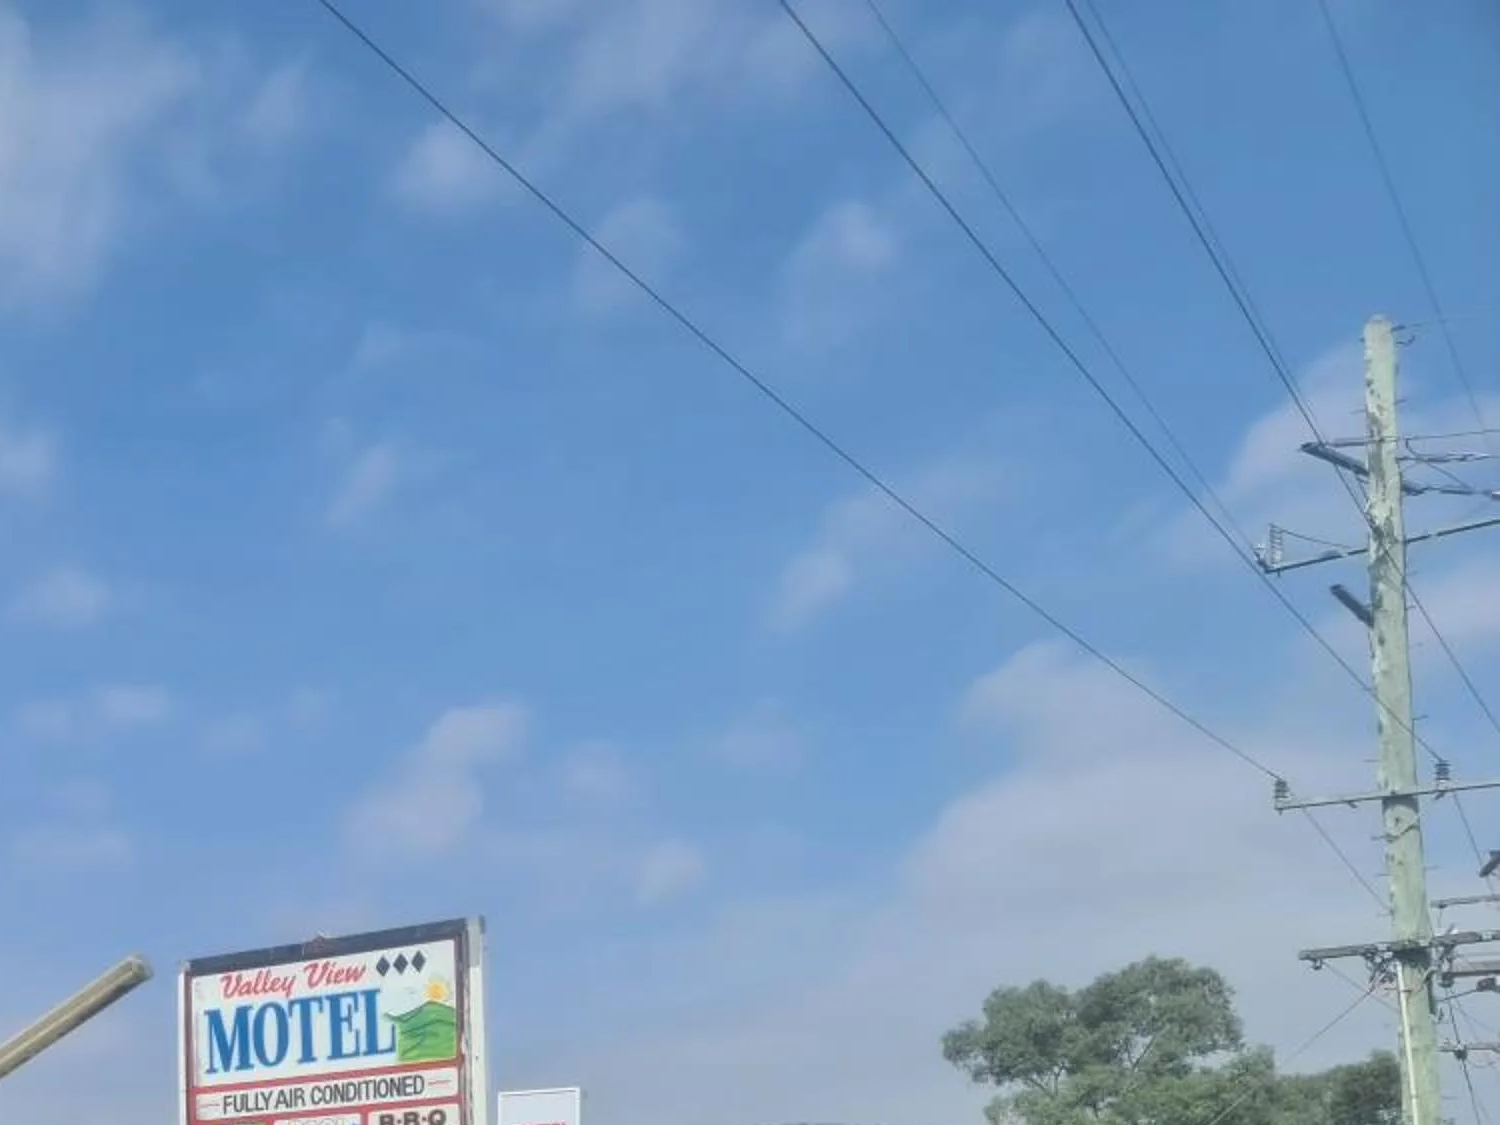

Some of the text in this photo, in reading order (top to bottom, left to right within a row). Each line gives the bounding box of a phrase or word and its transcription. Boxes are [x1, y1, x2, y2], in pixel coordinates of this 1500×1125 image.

[221, 961, 366, 998] Valley View
[204, 988, 396, 1074] MOTEL
[223, 1074, 425, 1115] FULLY AIR CONDITIONED
